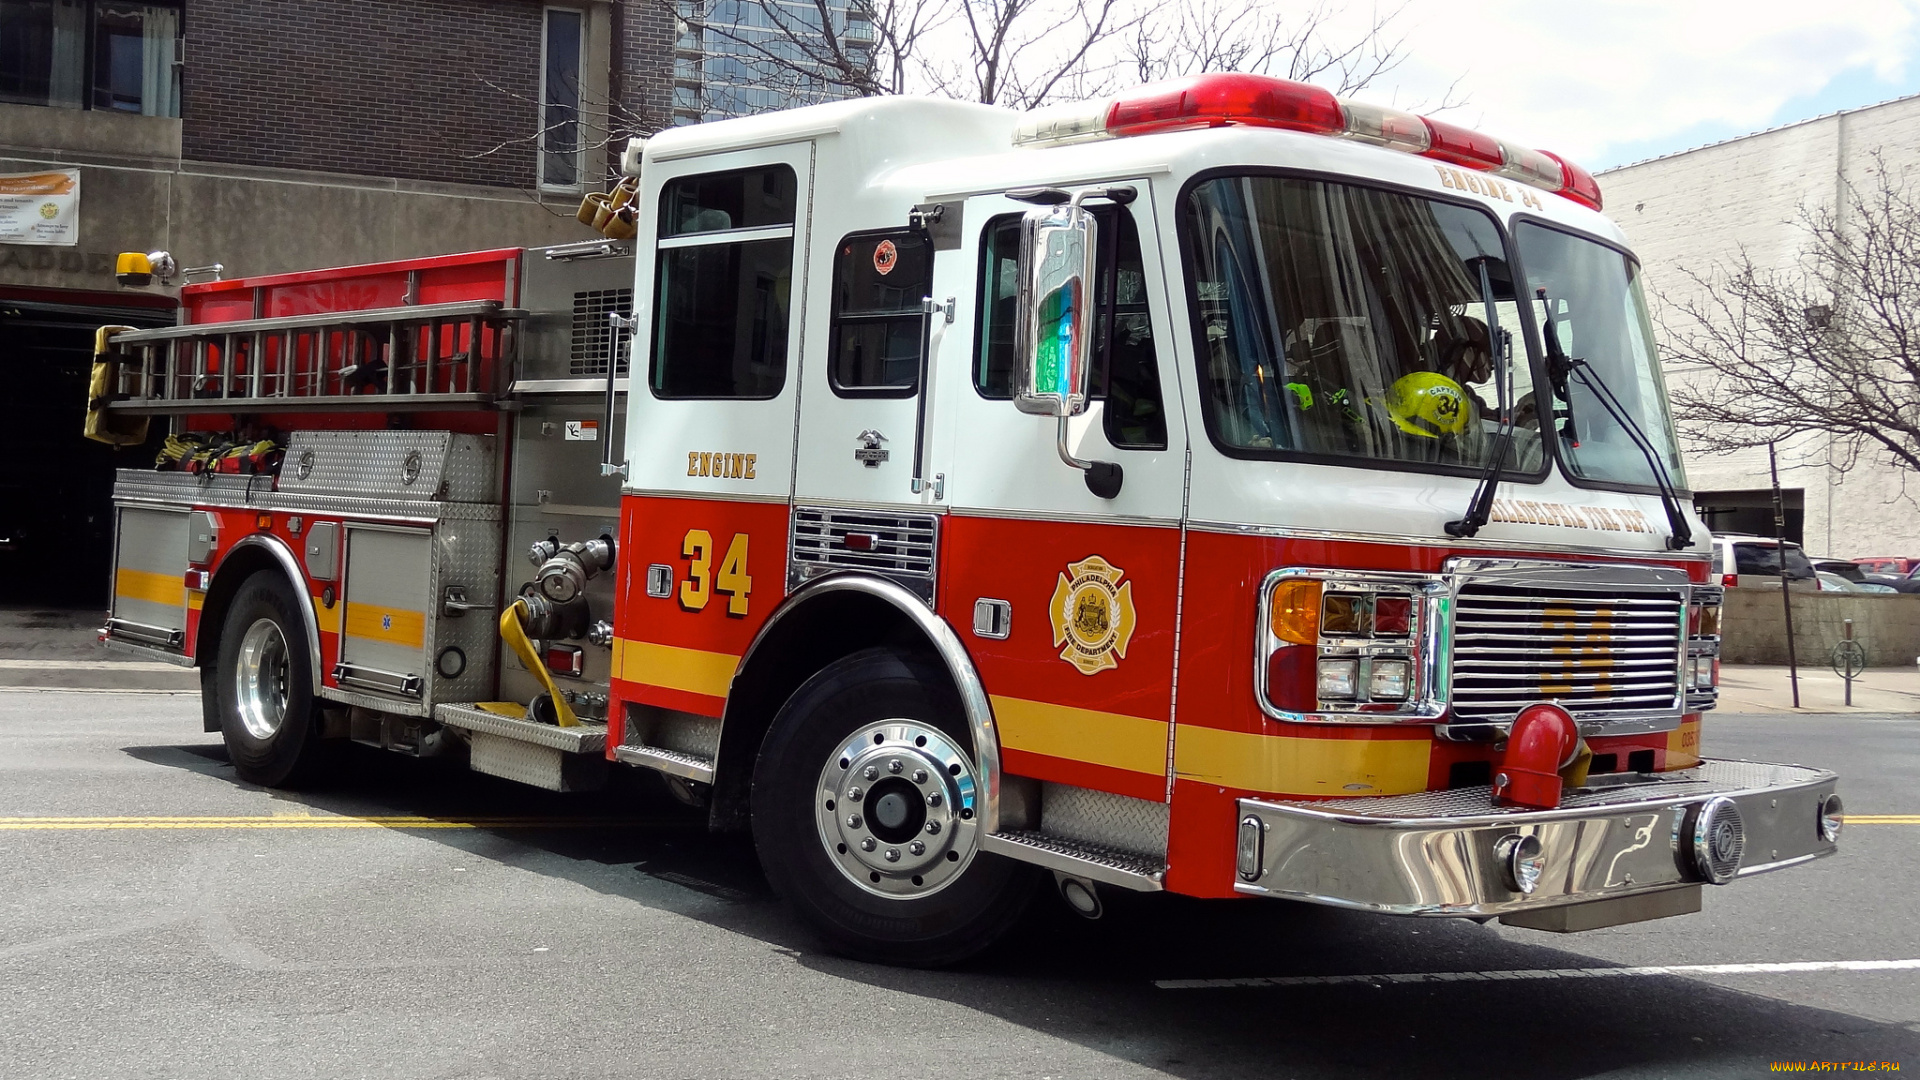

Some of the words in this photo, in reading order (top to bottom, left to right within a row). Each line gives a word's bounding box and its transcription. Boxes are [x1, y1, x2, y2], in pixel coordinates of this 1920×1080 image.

[1434, 164, 1513, 203] ENGINE
[1517, 185, 1543, 212] 34
[1430, 386, 1462, 403] CAPTAIN
[1438, 395, 1459, 417] 34
[687, 451, 757, 480] ENGINE
[1491, 498, 1588, 529] HILADELPHIA
[1580, 506, 1621, 531] FIRE
[679, 528, 752, 619] 34
[1071, 574, 1117, 598] PHILADELPHIA
[1064, 626, 1076, 647] FIRE
[1076, 633, 1118, 656] DEPARTMENT
[1537, 600, 1615, 699] 34
